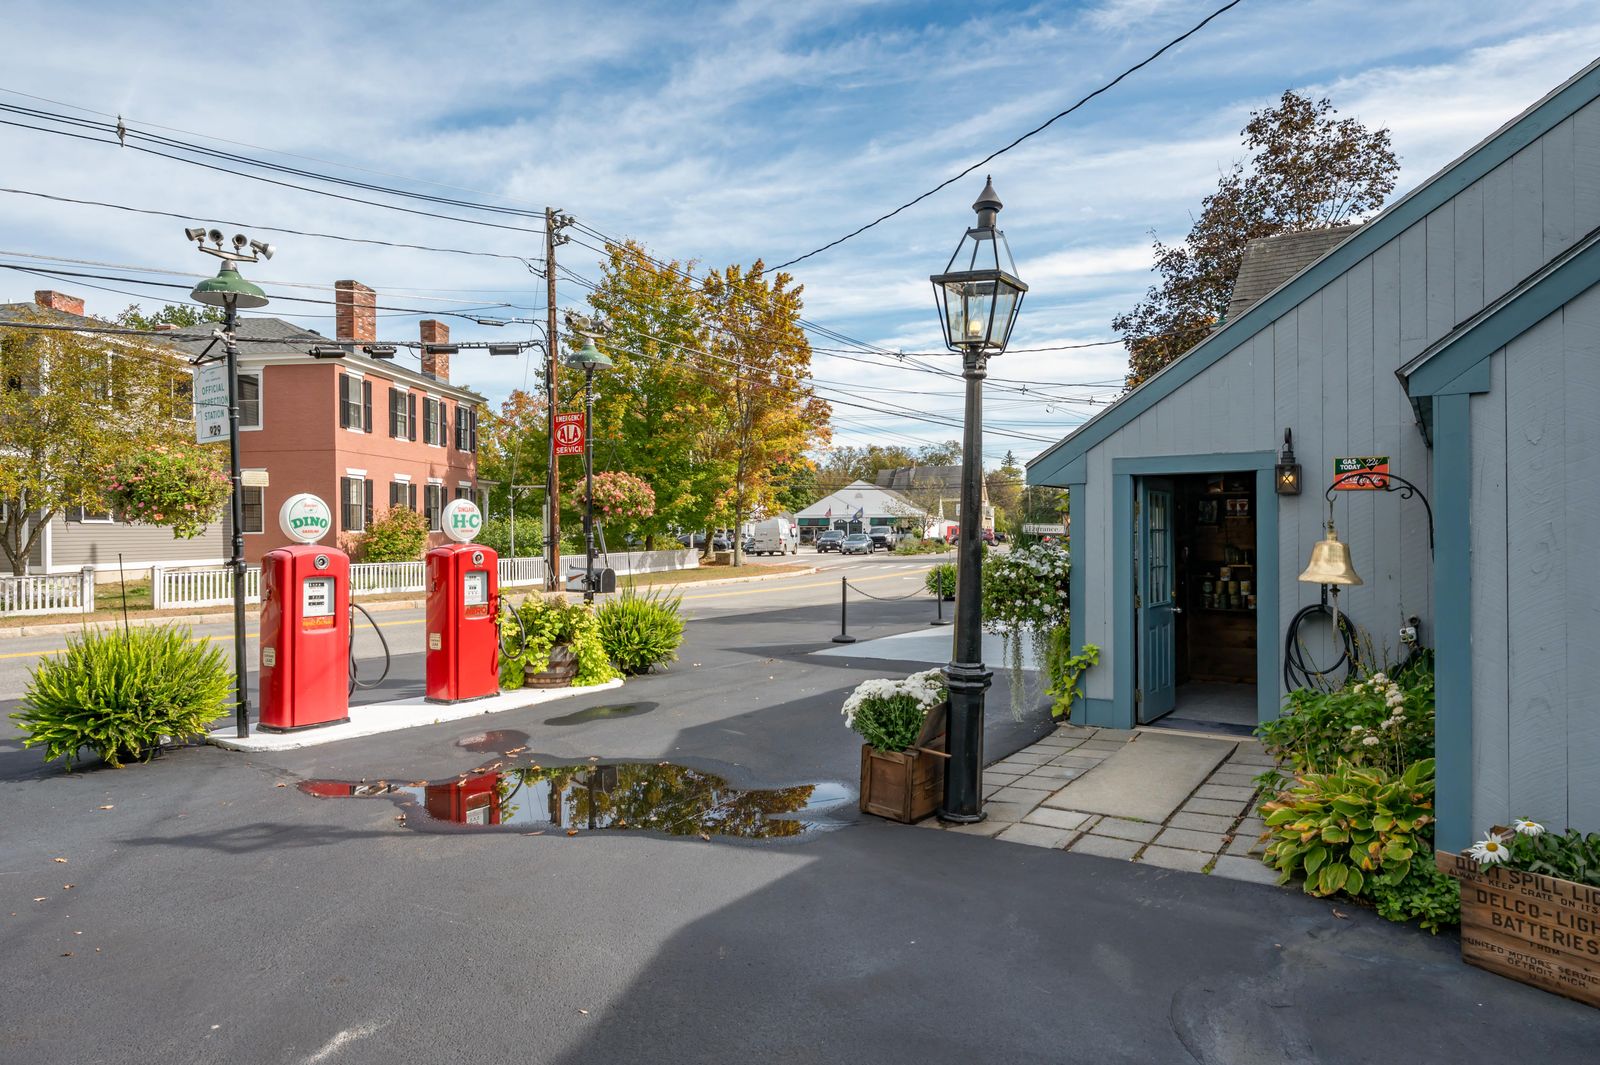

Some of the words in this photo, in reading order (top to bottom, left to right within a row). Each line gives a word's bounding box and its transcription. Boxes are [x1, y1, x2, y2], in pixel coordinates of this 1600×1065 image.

[202, 383, 225, 396] OFFICIAL
[204, 409, 225, 421] STATION
[560, 426, 579, 442] ALA
[556, 446, 583, 454] SERVICE
[291, 516, 328, 529] DINO
[1448, 867, 1483, 883] ALWAYS
[1488, 880, 1515, 890] KEEP
[1521, 887, 1553, 901] CRATE
[1560, 898, 1576, 908] ON
[1581, 904, 1599, 914] ITS
[1509, 870, 1563, 896] SPILL
[1491, 911, 1599, 955] BATTERIES
[1467, 937, 1504, 954] UNITED
[1508, 951, 1551, 970] MOTORS
